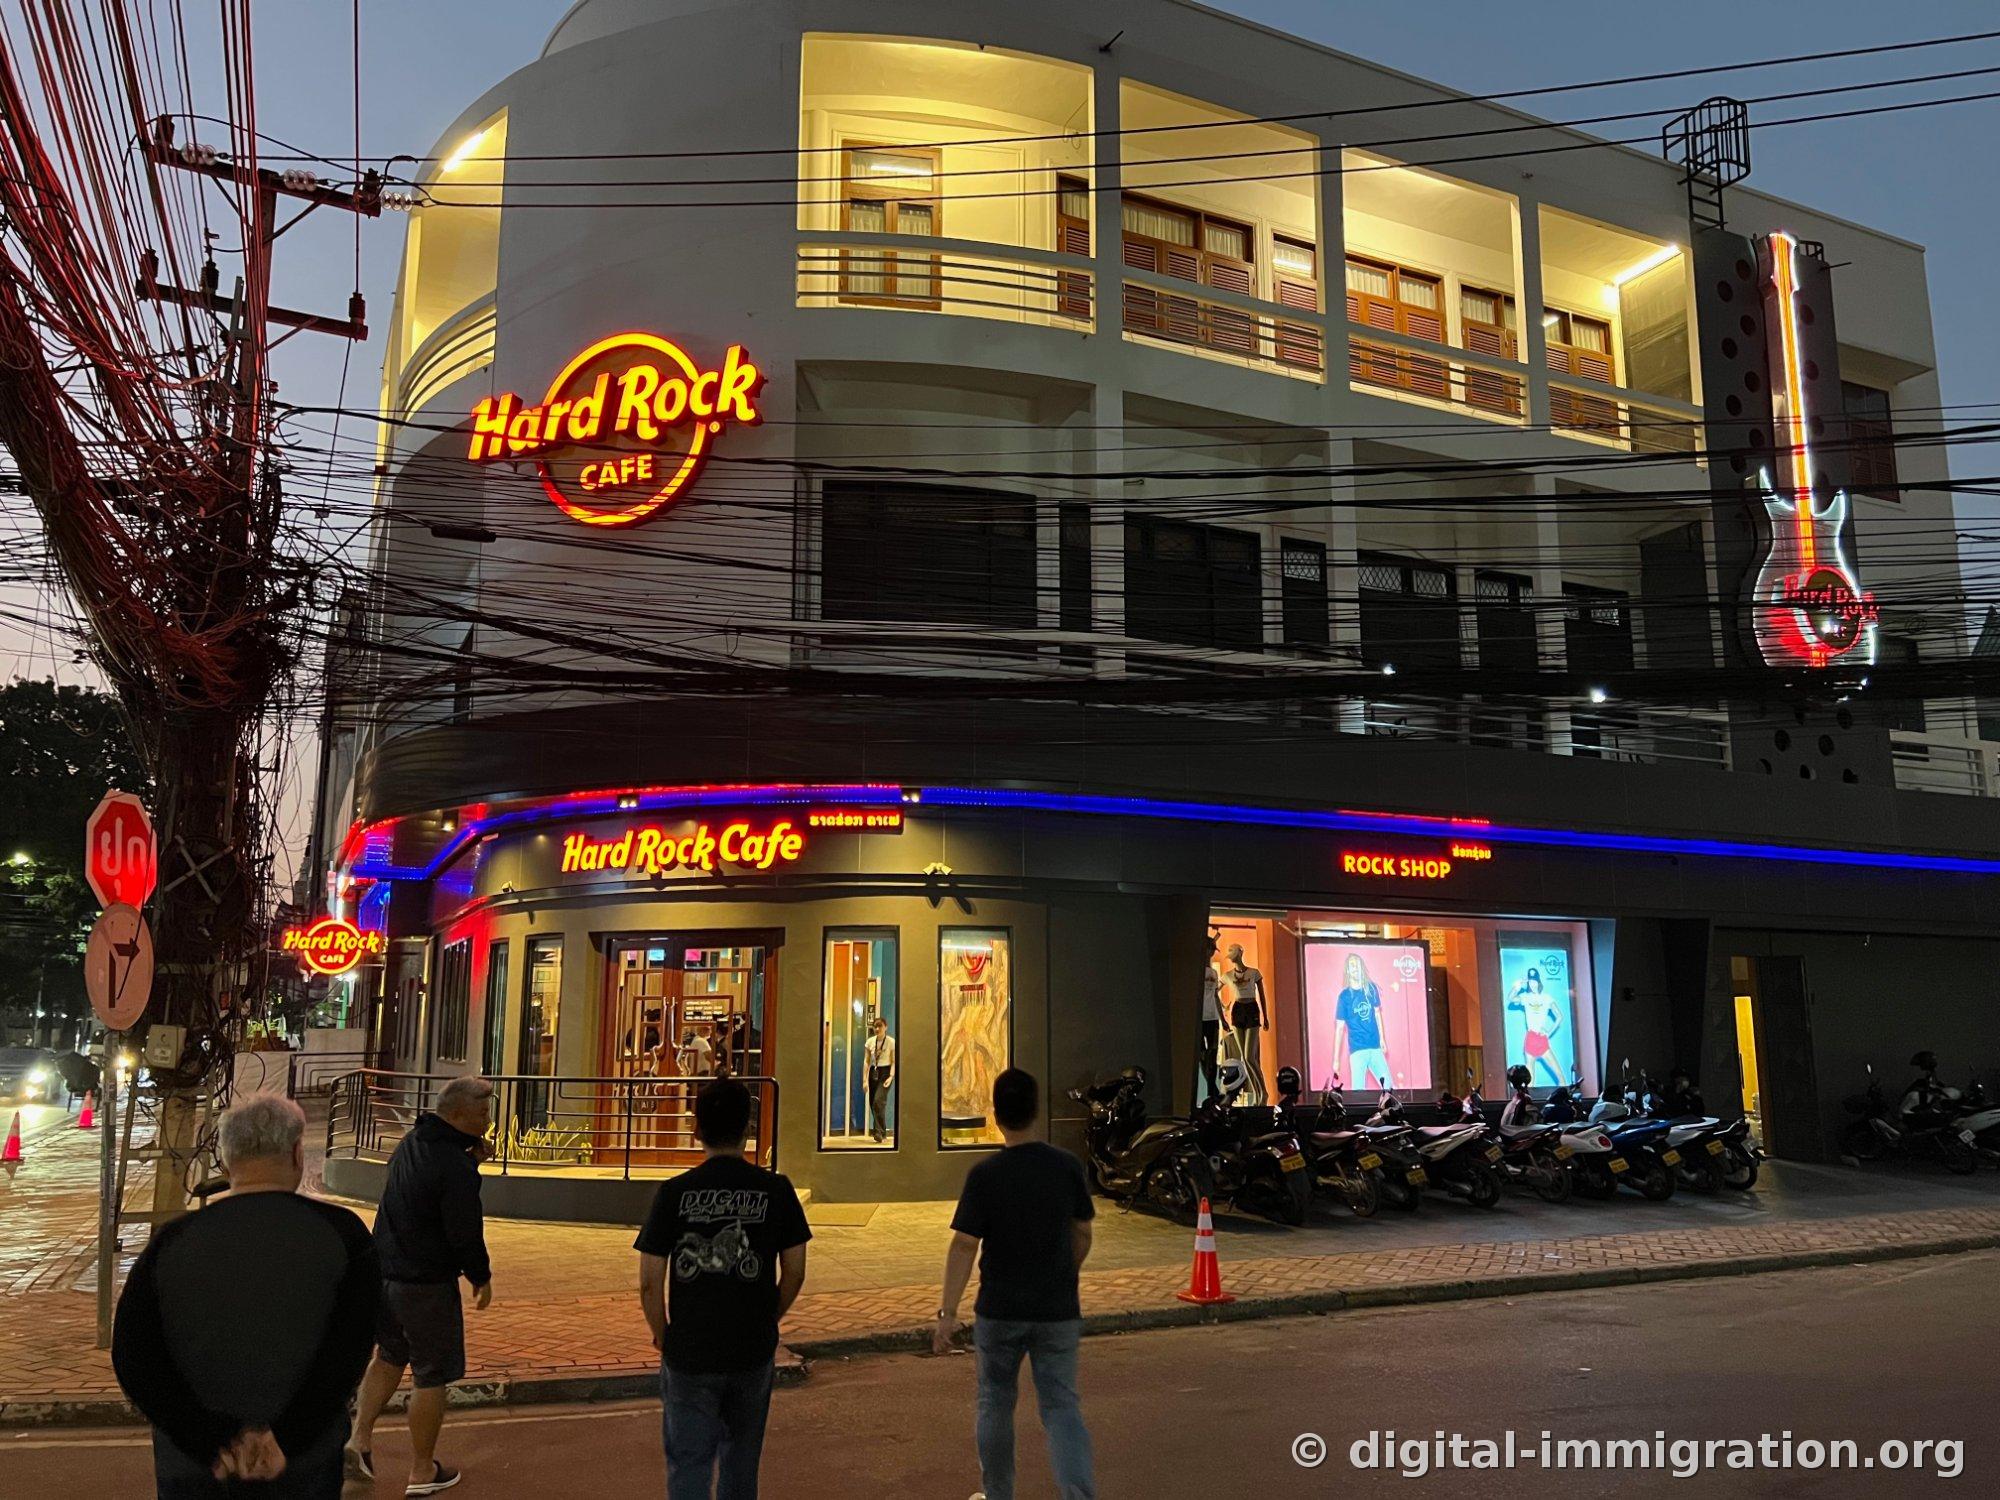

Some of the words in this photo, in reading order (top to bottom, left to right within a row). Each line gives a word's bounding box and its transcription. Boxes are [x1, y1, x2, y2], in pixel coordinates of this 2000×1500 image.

[468, 372, 611, 460] Hard
[614, 344, 758, 440] Rock
[579, 454, 652, 490] CAFE
[561, 830, 633, 872] Hard
[635, 826, 715, 874] Rock
[719, 822, 802, 870] Cafe
[1343, 855, 1396, 876] ROCK
[1400, 859, 1451, 878] SHOP
[283, 930, 333, 950] Hard
[334, 930, 380, 953] Rock
[319, 954, 345, 963] CAFE
